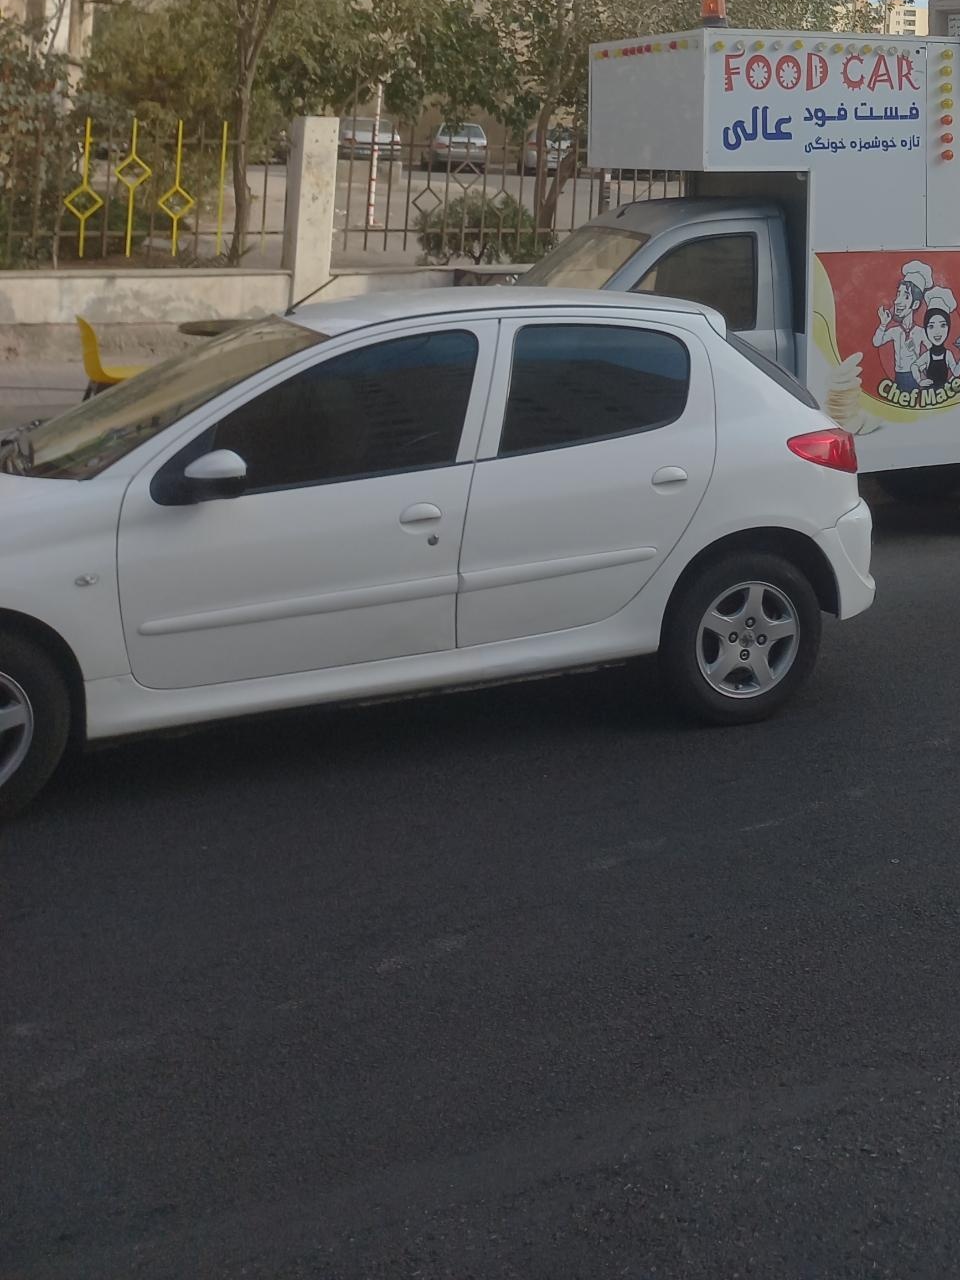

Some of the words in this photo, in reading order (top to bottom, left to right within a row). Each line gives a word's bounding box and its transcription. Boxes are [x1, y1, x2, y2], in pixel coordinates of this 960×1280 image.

[724, 49, 829, 92] FOOD
[841, 53, 920, 92] CAR
[802, 101, 848, 127] فود
[853, 101, 920, 121] فست
[722, 105, 793, 151] عالی
[803, 135, 847, 154] خونگی
[849, 136, 898, 153] خوشمزه
[900, 134, 921, 152] تازه
[877, 379, 918, 407] Chef
